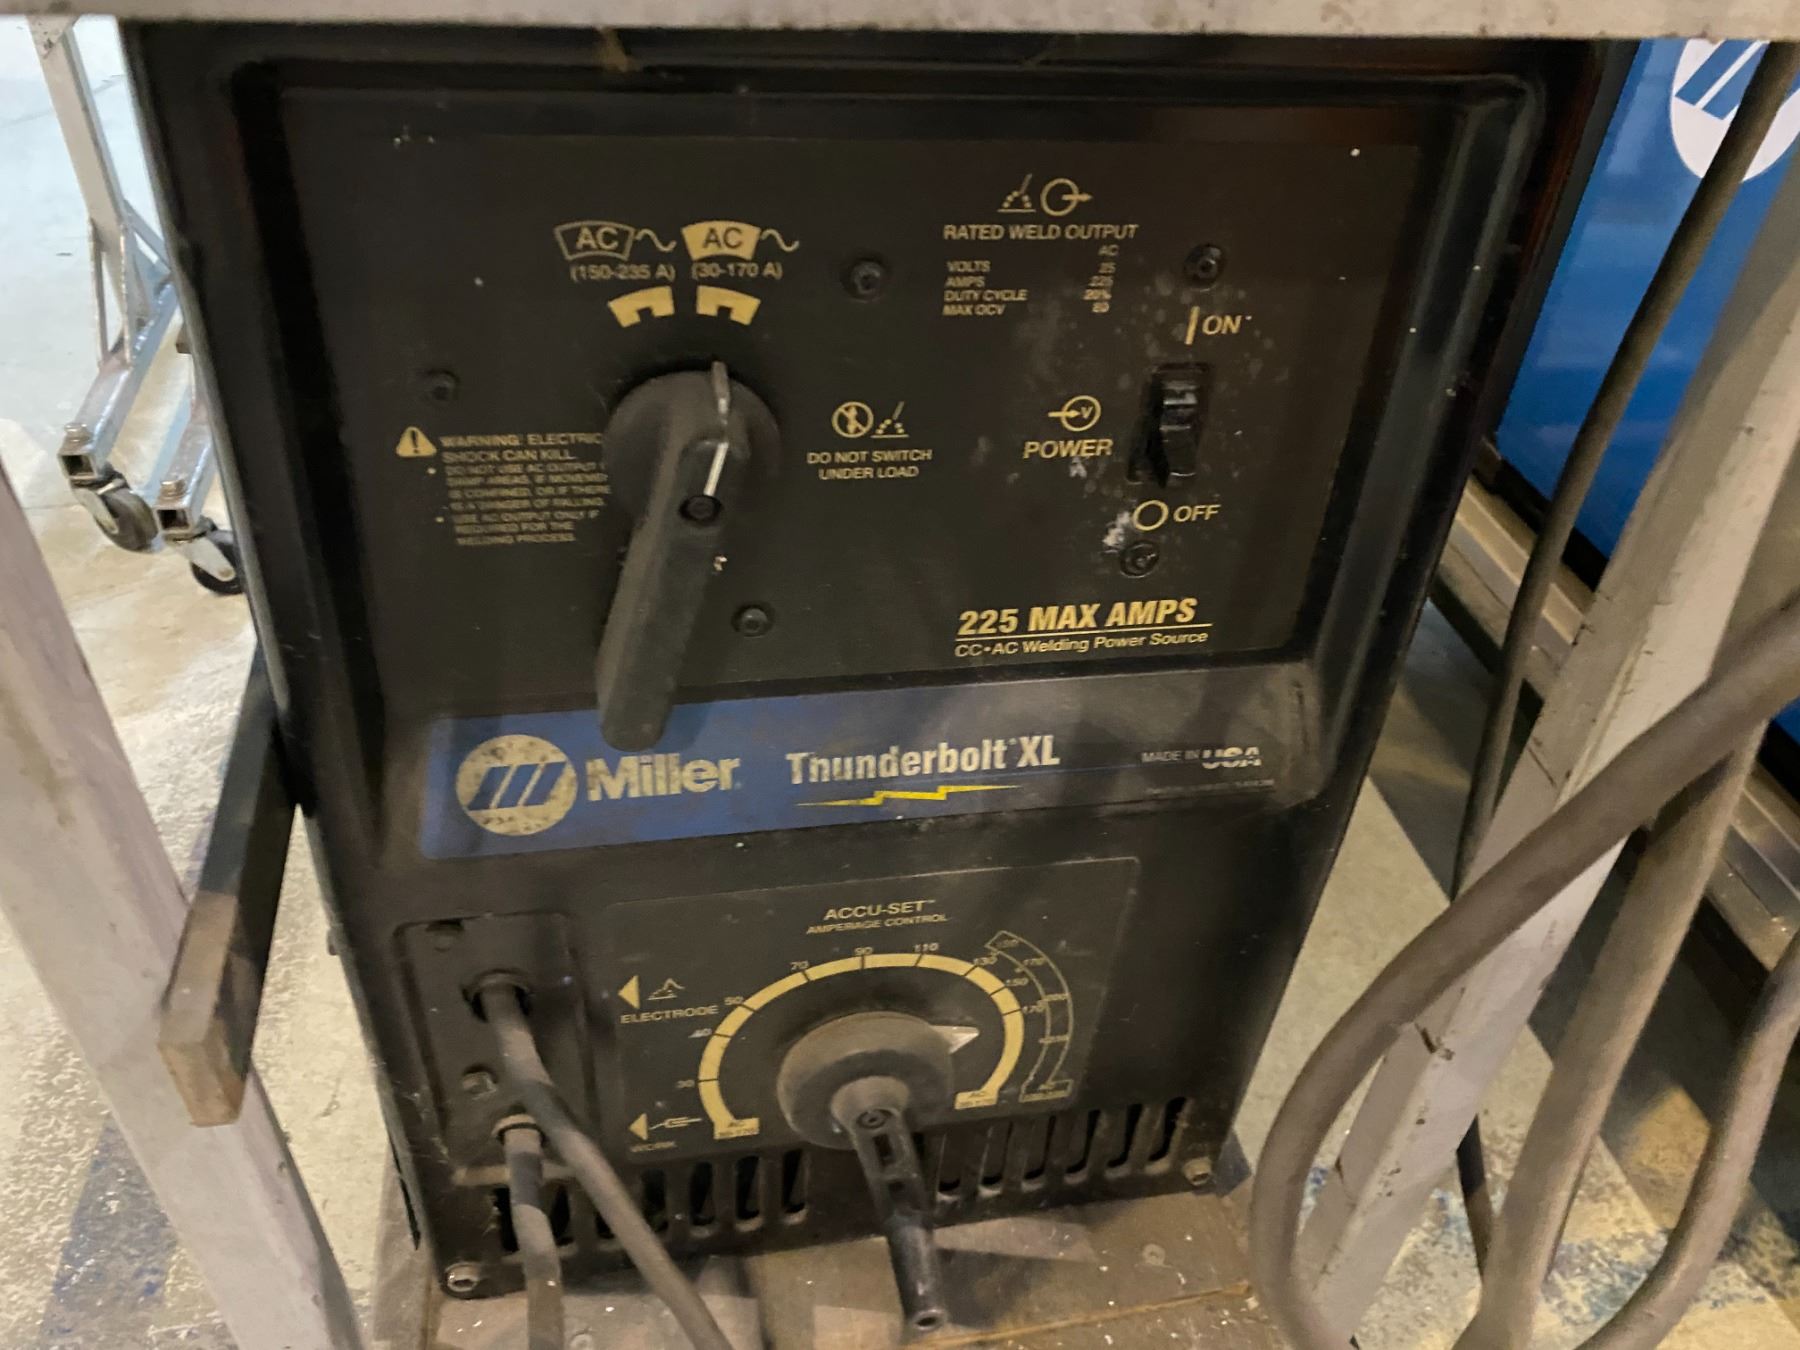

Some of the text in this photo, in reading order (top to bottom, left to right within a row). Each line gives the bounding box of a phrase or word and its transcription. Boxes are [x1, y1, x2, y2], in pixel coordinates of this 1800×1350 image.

[575, 227, 619, 250] AC
[702, 227, 744, 249] AC
[943, 223, 1139, 240] RATED WELD OUTPUT
[691, 261, 784, 279] (30-170 A)
[946, 260, 991, 273] VOLTS
[945, 275, 986, 288] AMPS
[943, 289, 980, 301] DUTY
[982, 288, 1029, 301] CYCLE
[942, 303, 973, 316] MAX
[974, 303, 1006, 316] OCV
[1201, 314, 1242, 335] ON
[442, 451, 500, 463] SHOCK
[503, 450, 538, 462] CAN
[807, 448, 933, 464] DO NOT SWITCH
[1023, 438, 1114, 459] POWER
[818, 465, 920, 480] UNDER LOAD
[1173, 503, 1222, 523] OFF
[957, 597, 1199, 636] 225 MAX AMPS
[1022, 636, 1090, 653] Welding
[1093, 634, 1145, 650] Power
[1148, 631, 1209, 646] Source
[1141, 750, 1183, 763] MADE
[585, 734, 1062, 802] Miller Thunderbolt XL
[806, 913, 949, 935] AMPERAGE CONTROL
[855, 946, 874, 956] 90
[914, 943, 941, 953] 110
[619, 1004, 720, 1025] ELECTRODE
